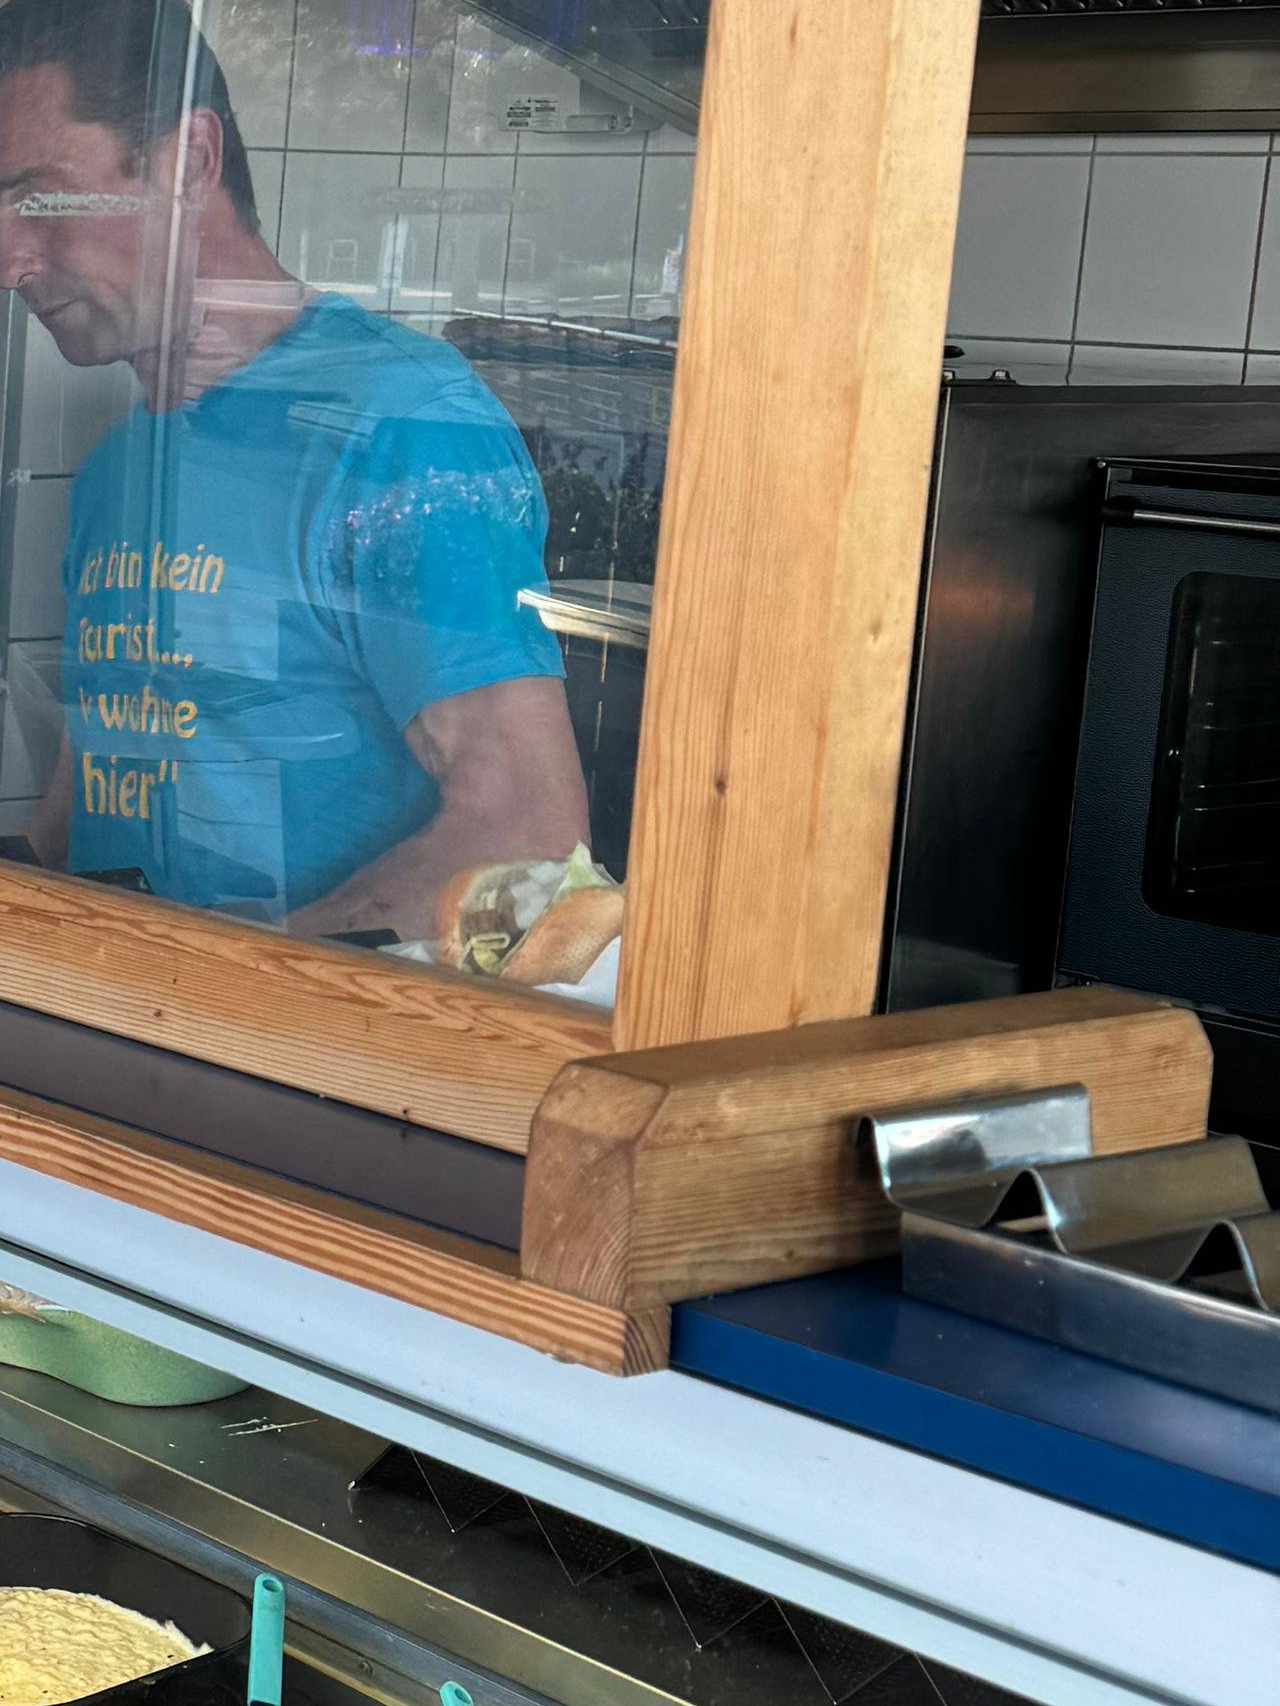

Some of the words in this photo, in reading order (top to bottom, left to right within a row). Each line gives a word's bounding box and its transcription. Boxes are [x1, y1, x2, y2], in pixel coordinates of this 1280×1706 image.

[104, 541, 141, 589] bin
[149, 540, 224, 594] kein
[97, 684, 198, 740] wohne
